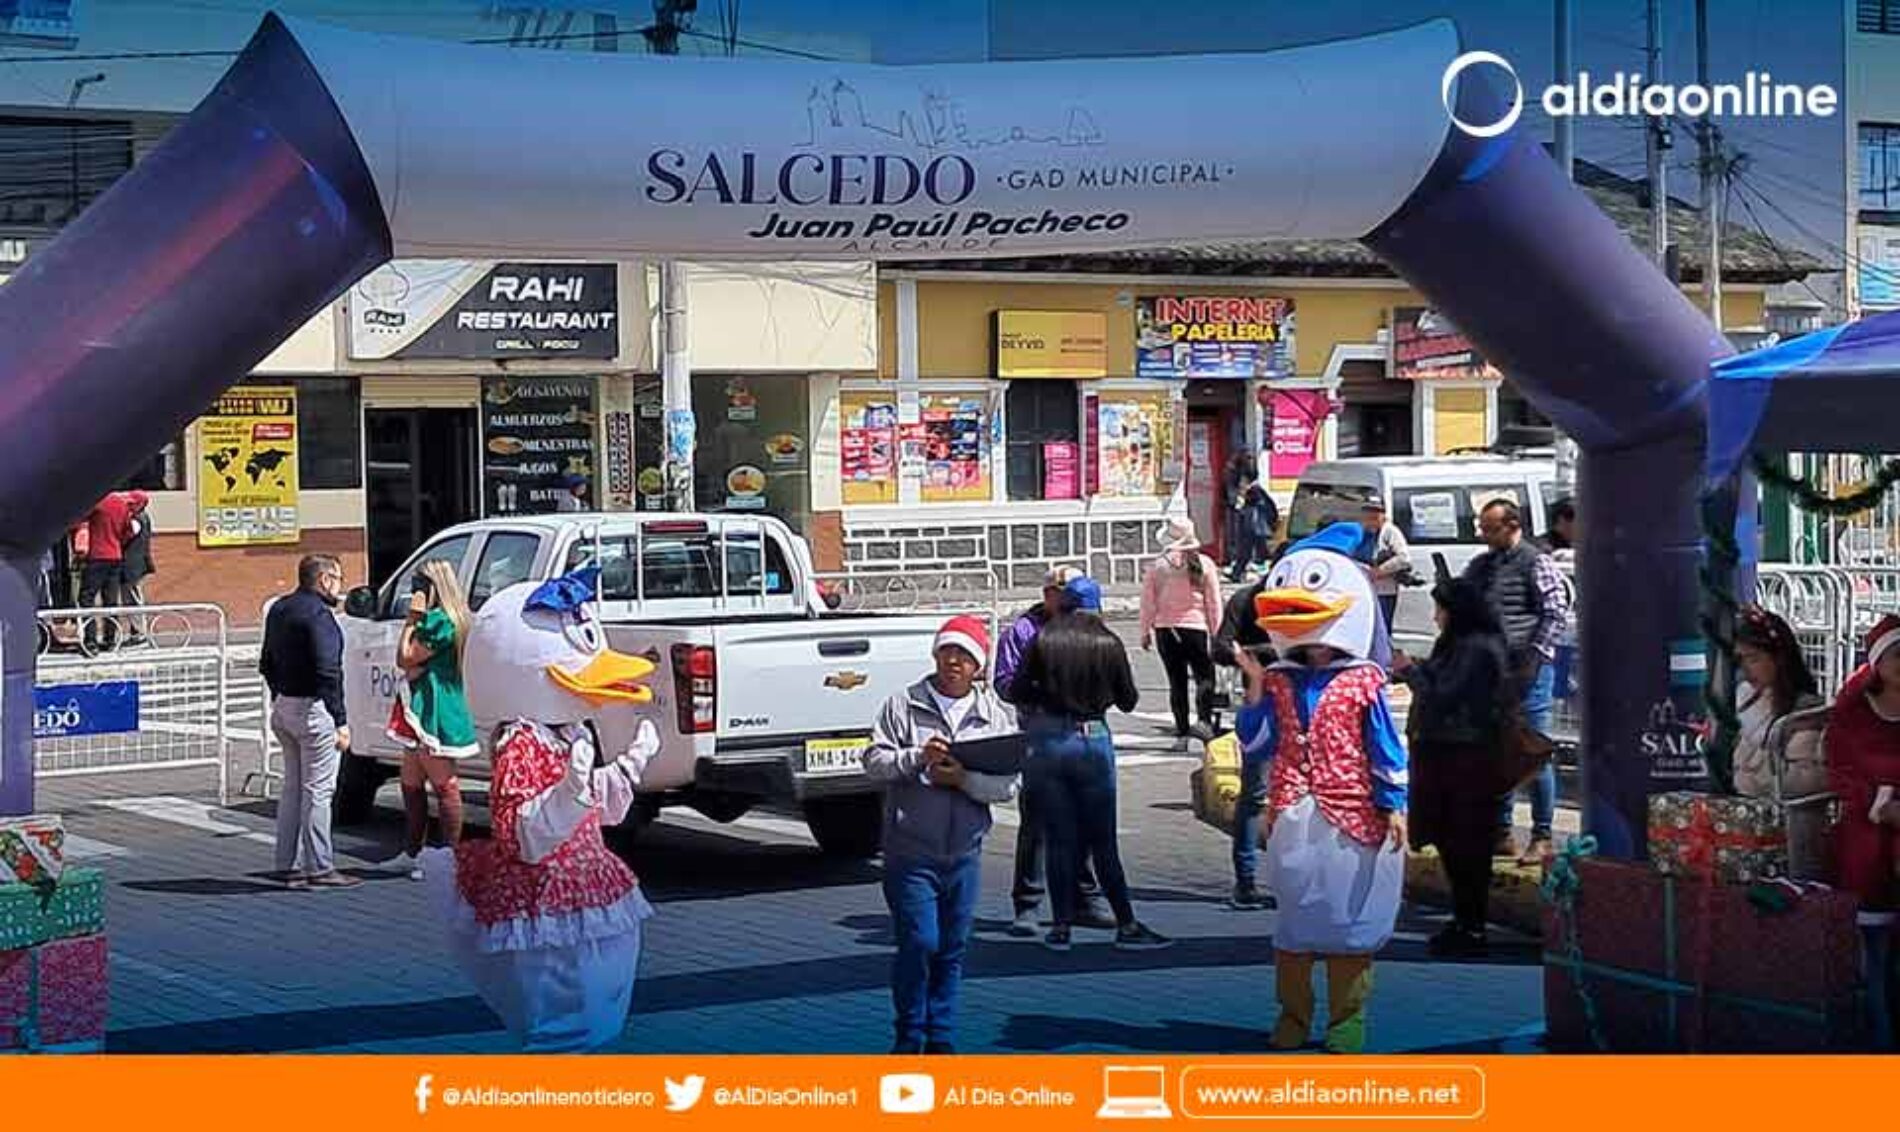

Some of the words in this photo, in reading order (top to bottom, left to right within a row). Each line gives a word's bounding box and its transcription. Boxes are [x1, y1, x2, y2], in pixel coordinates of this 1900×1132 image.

[645, 149, 976, 206] SALCEDO
[1007, 168, 1064, 190] GAD
[1076, 163, 1220, 187] MUNICIPAL
[749, 212, 855, 238] Juan
[863, 211, 957, 238] Paúl
[962, 209, 1129, 236] Pacheco
[489, 276, 584, 302] RAHI
[457, 311, 615, 330] RESTAURANT
[1155, 297, 1286, 323] INTERNET
[1170, 322, 1276, 342] PAPELERIA
